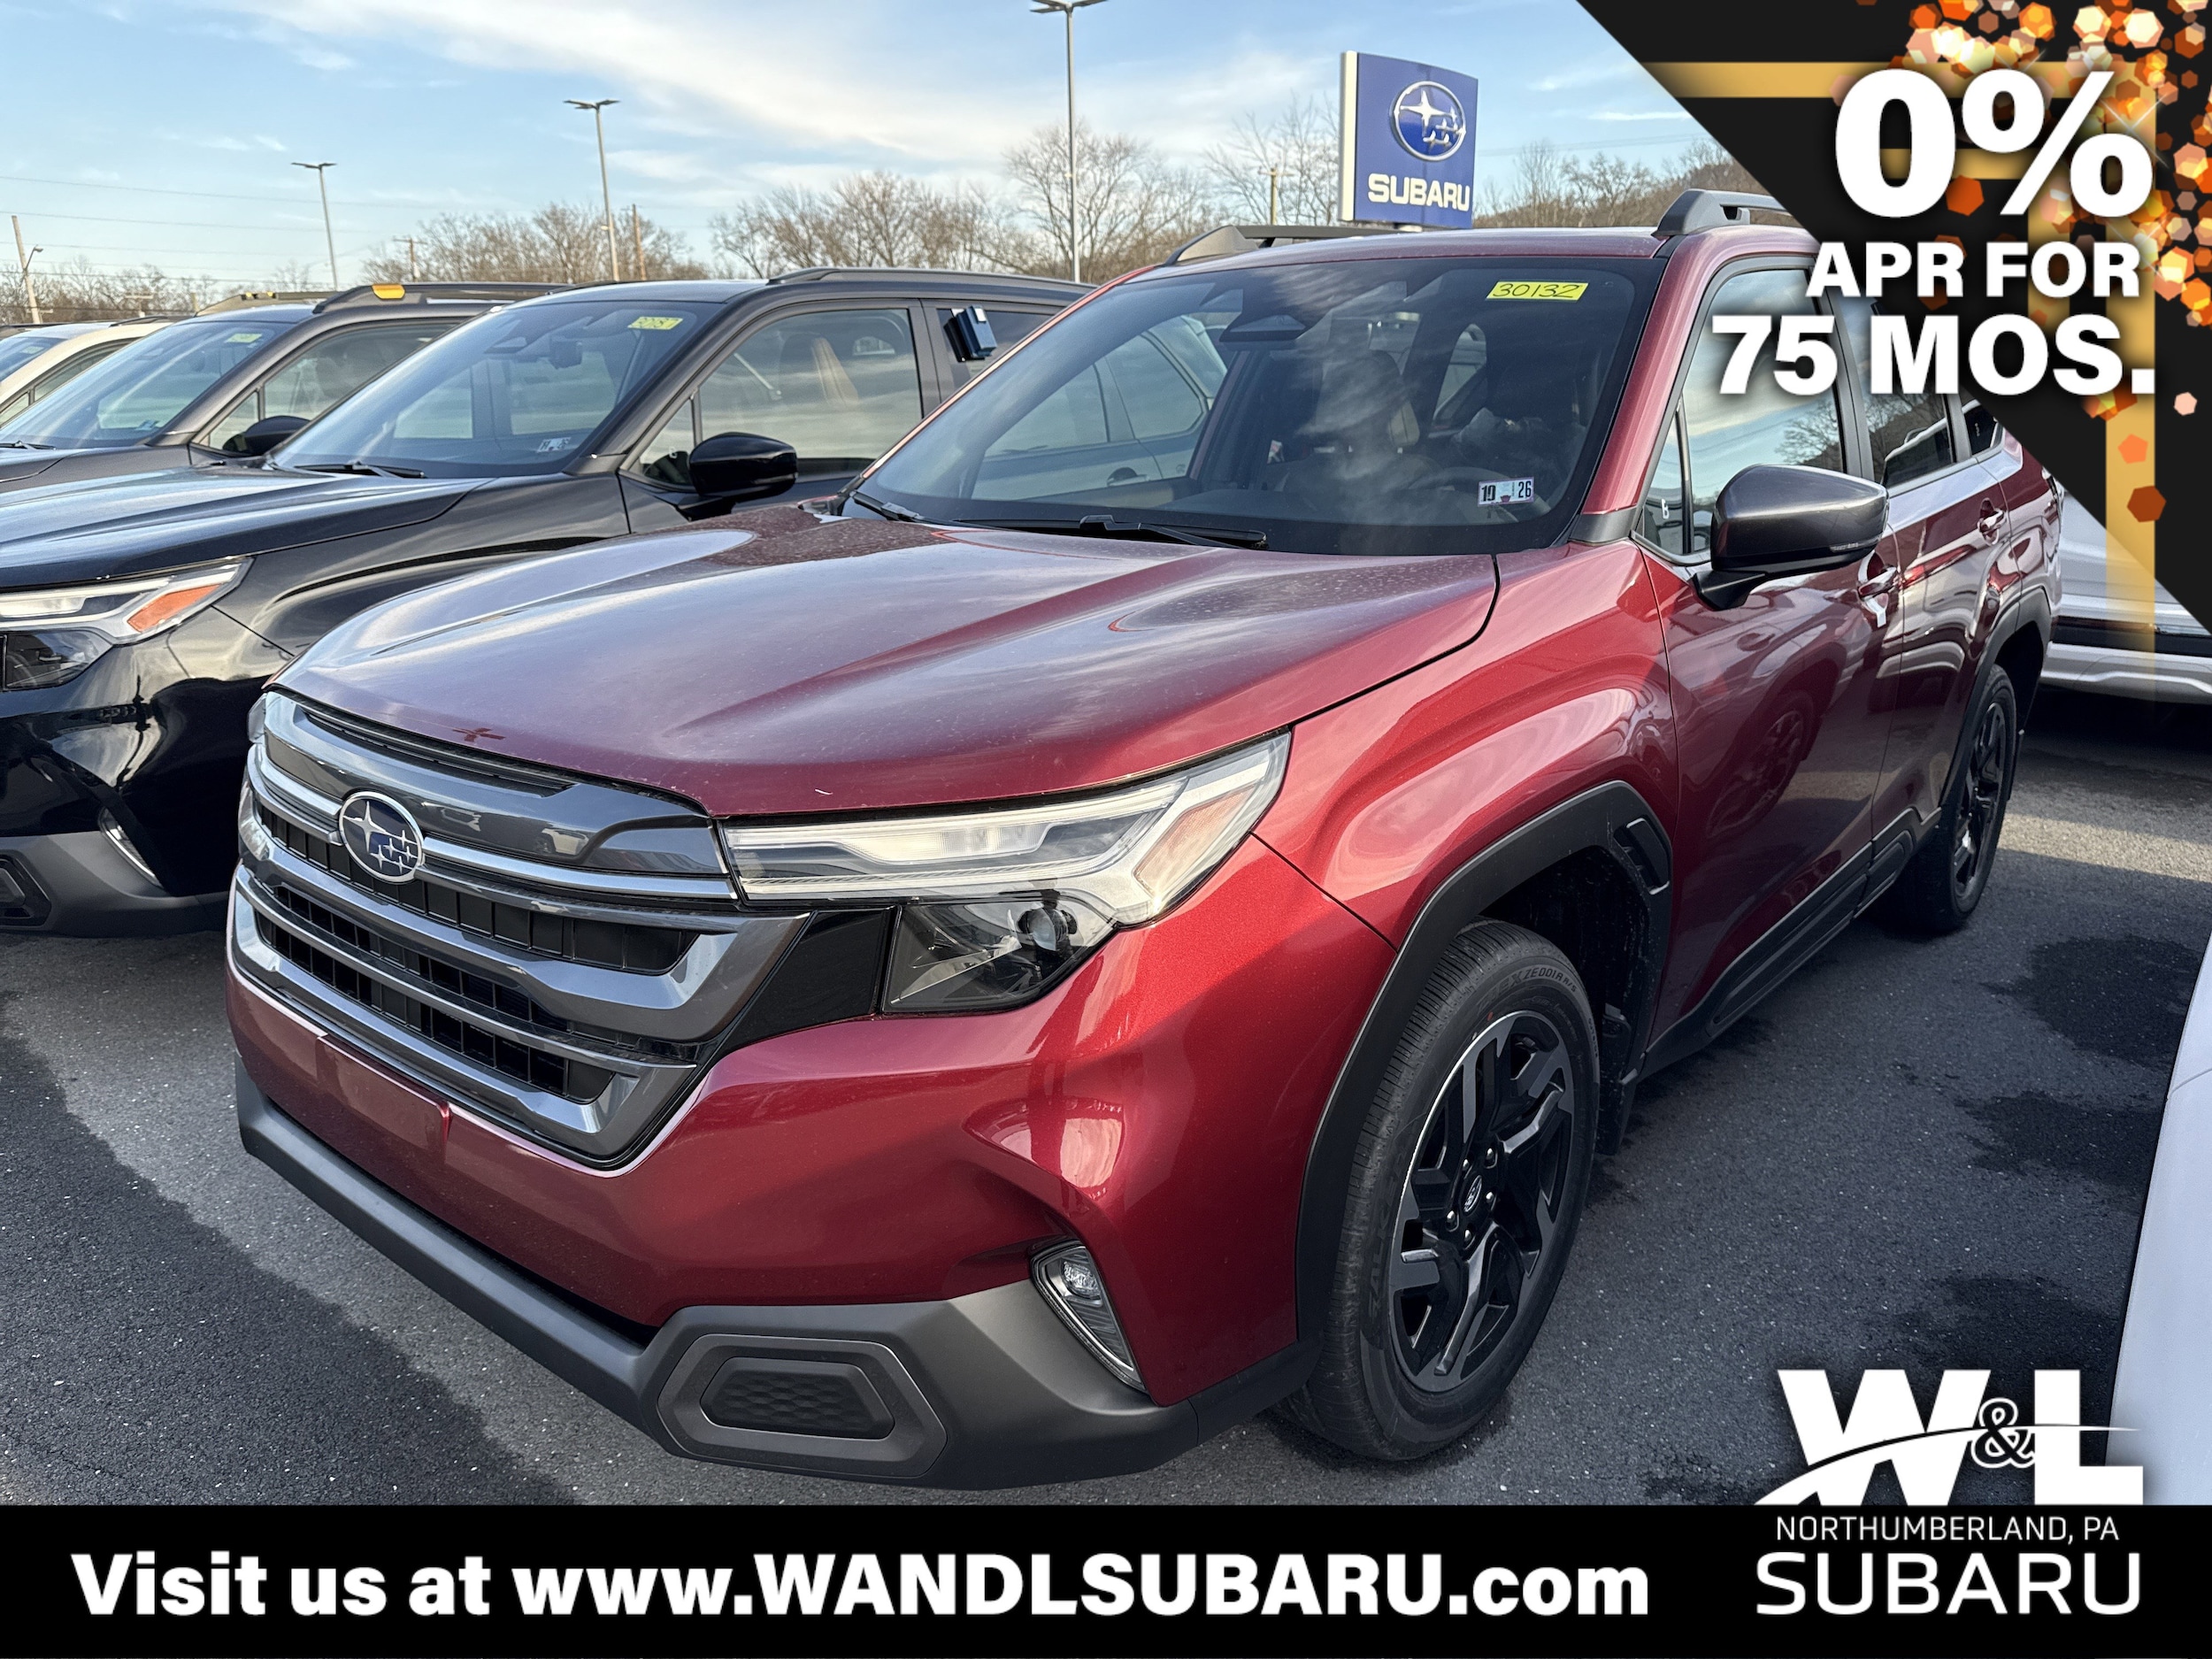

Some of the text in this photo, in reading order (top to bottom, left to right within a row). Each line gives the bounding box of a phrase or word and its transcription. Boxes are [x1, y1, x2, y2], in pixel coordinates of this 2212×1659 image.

[1368, 173, 1470, 211] SUBARU
[1493, 283, 1580, 298] 30132
[1518, 480, 1532, 498] 26
